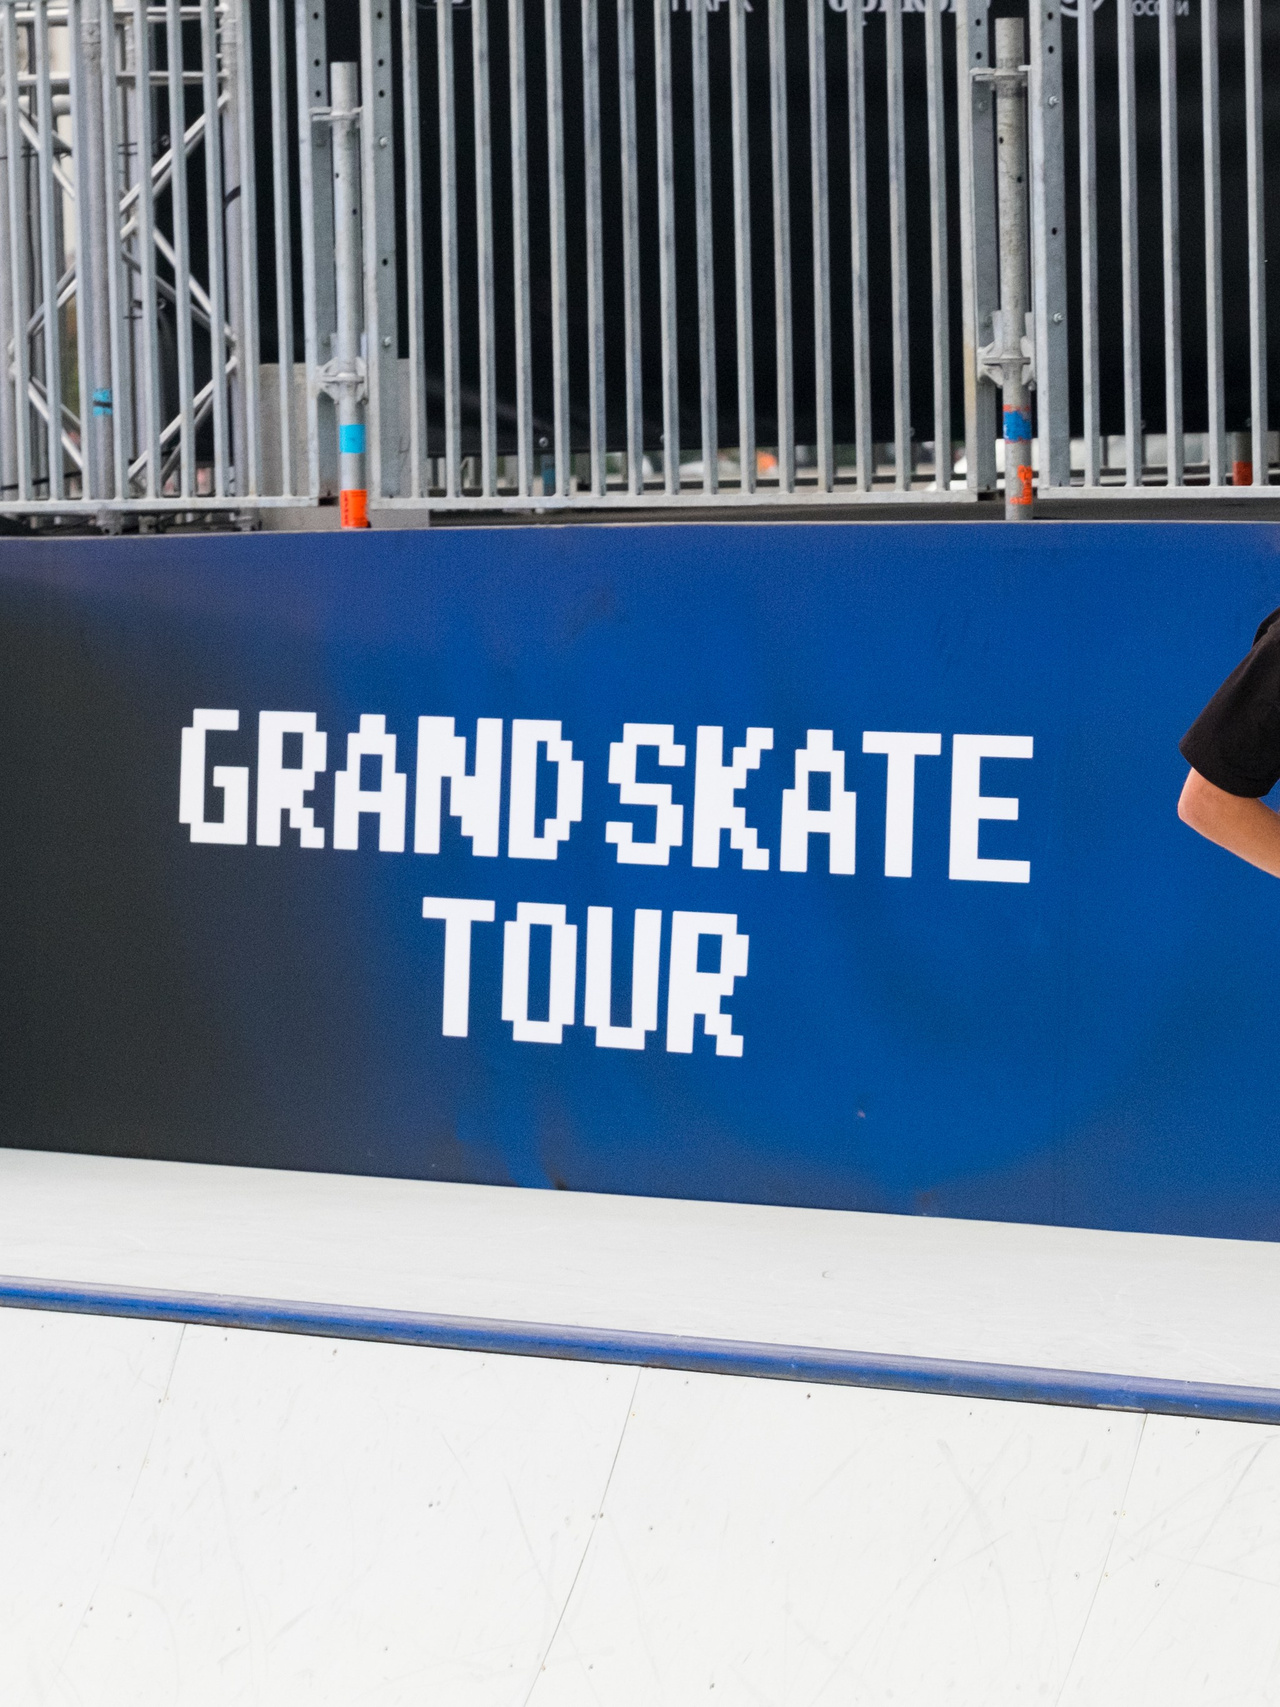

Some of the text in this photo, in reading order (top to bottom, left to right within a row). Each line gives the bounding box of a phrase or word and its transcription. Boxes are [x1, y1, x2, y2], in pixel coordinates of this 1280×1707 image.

[179, 708, 1033, 883] GRAND SKATE
[422, 896, 749, 1057] TOUR
